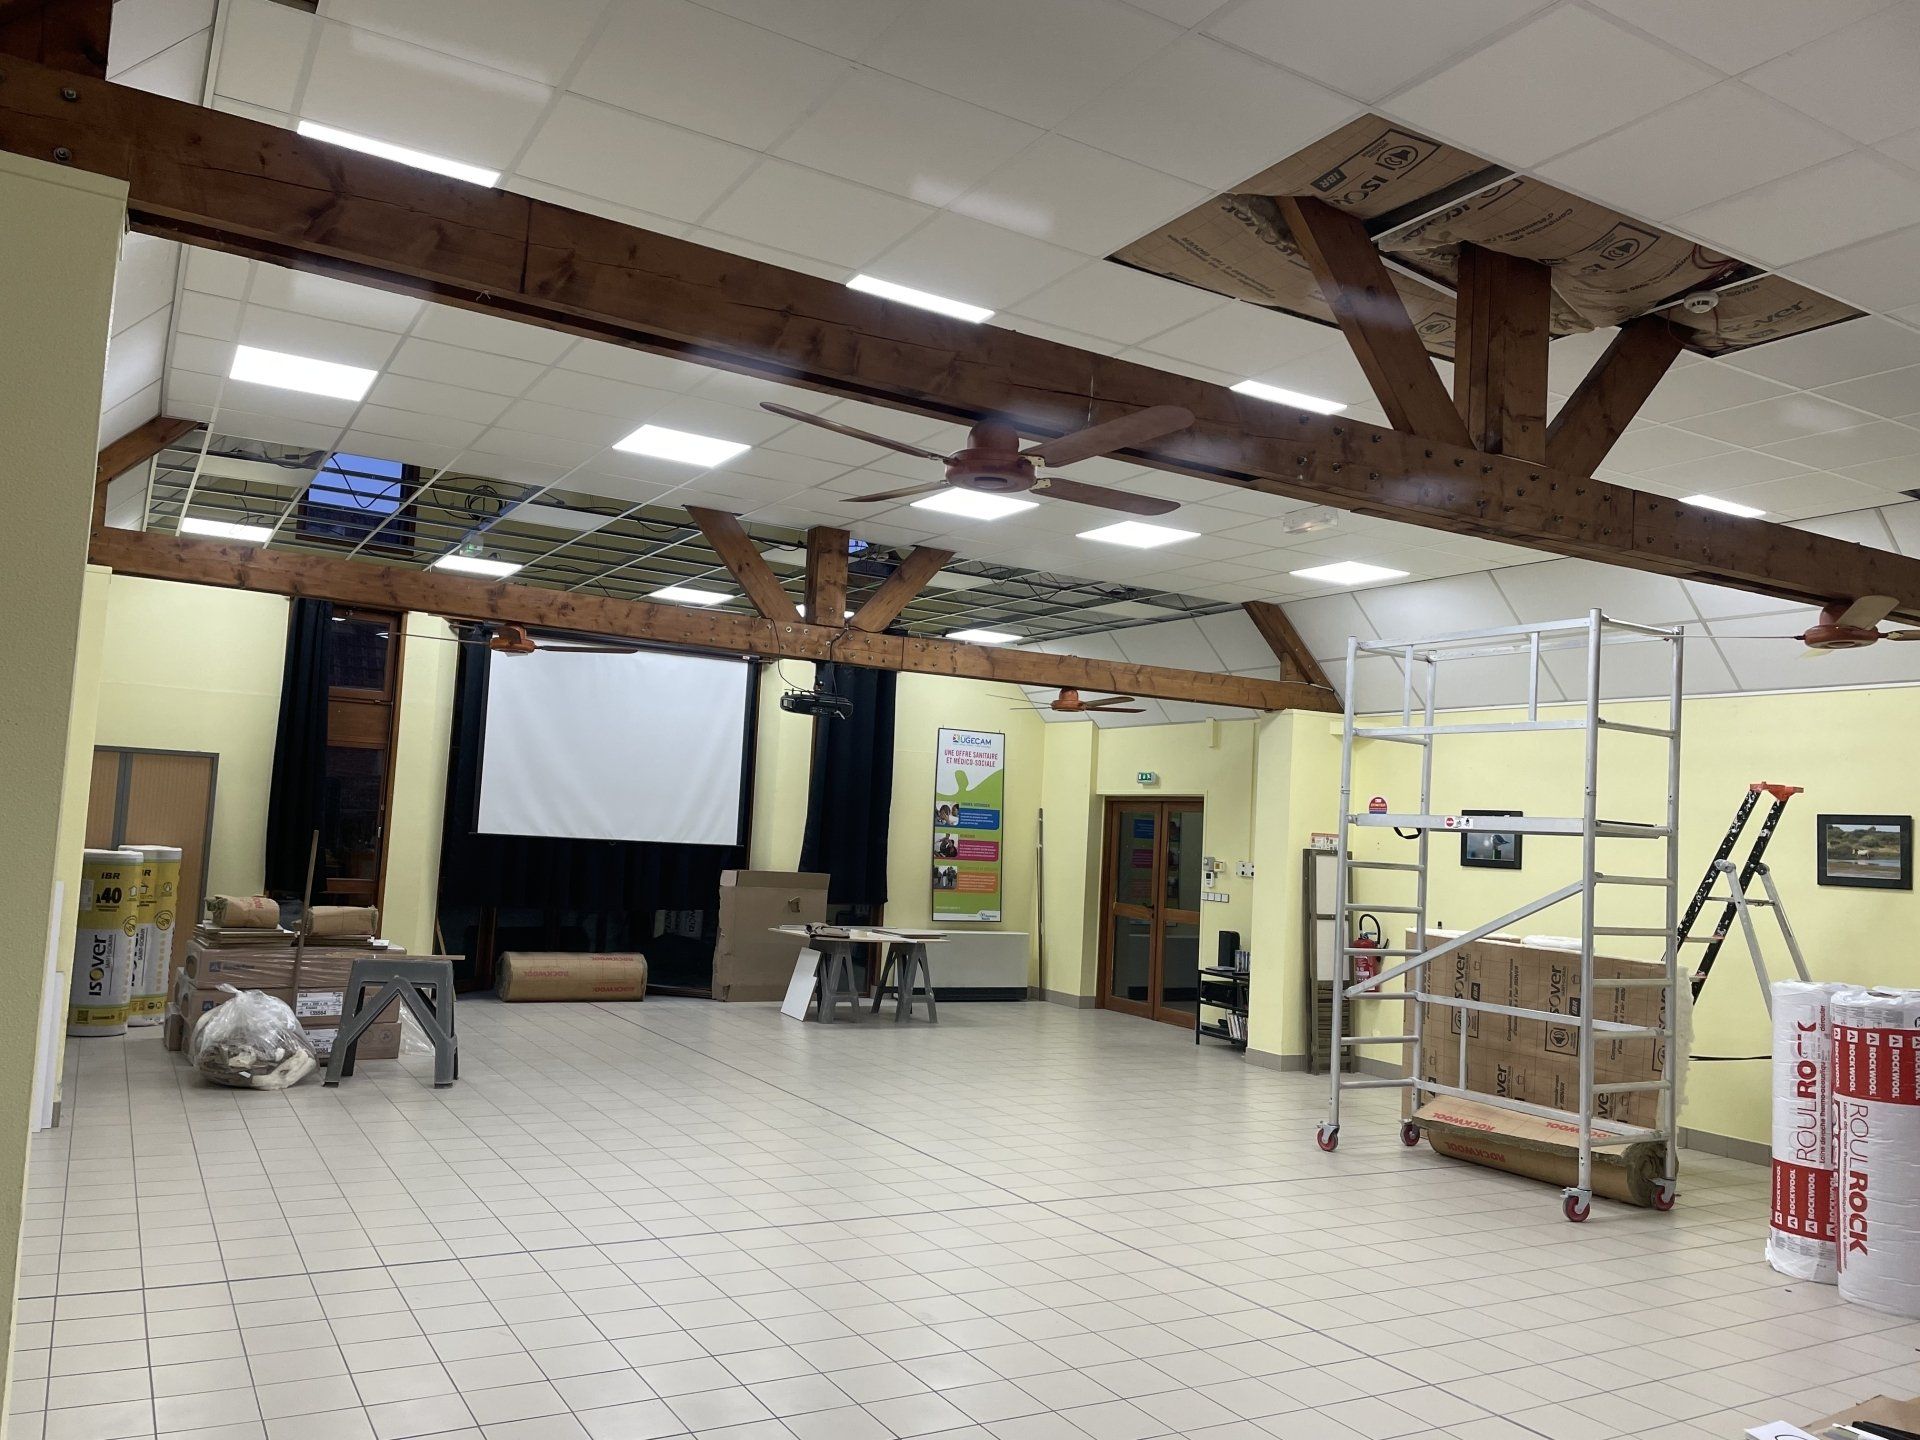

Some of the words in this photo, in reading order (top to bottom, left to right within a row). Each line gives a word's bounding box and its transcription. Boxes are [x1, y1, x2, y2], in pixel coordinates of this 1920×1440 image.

[1319, 172, 1340, 188] IBR
[961, 737, 991, 745] UGECAM
[954, 758, 995, 767] MÉDICO-SOCIALE
[1432, 1112, 1495, 1132] ROCKWOOL
[1444, 1142, 1505, 1163] ROCKWOOL
